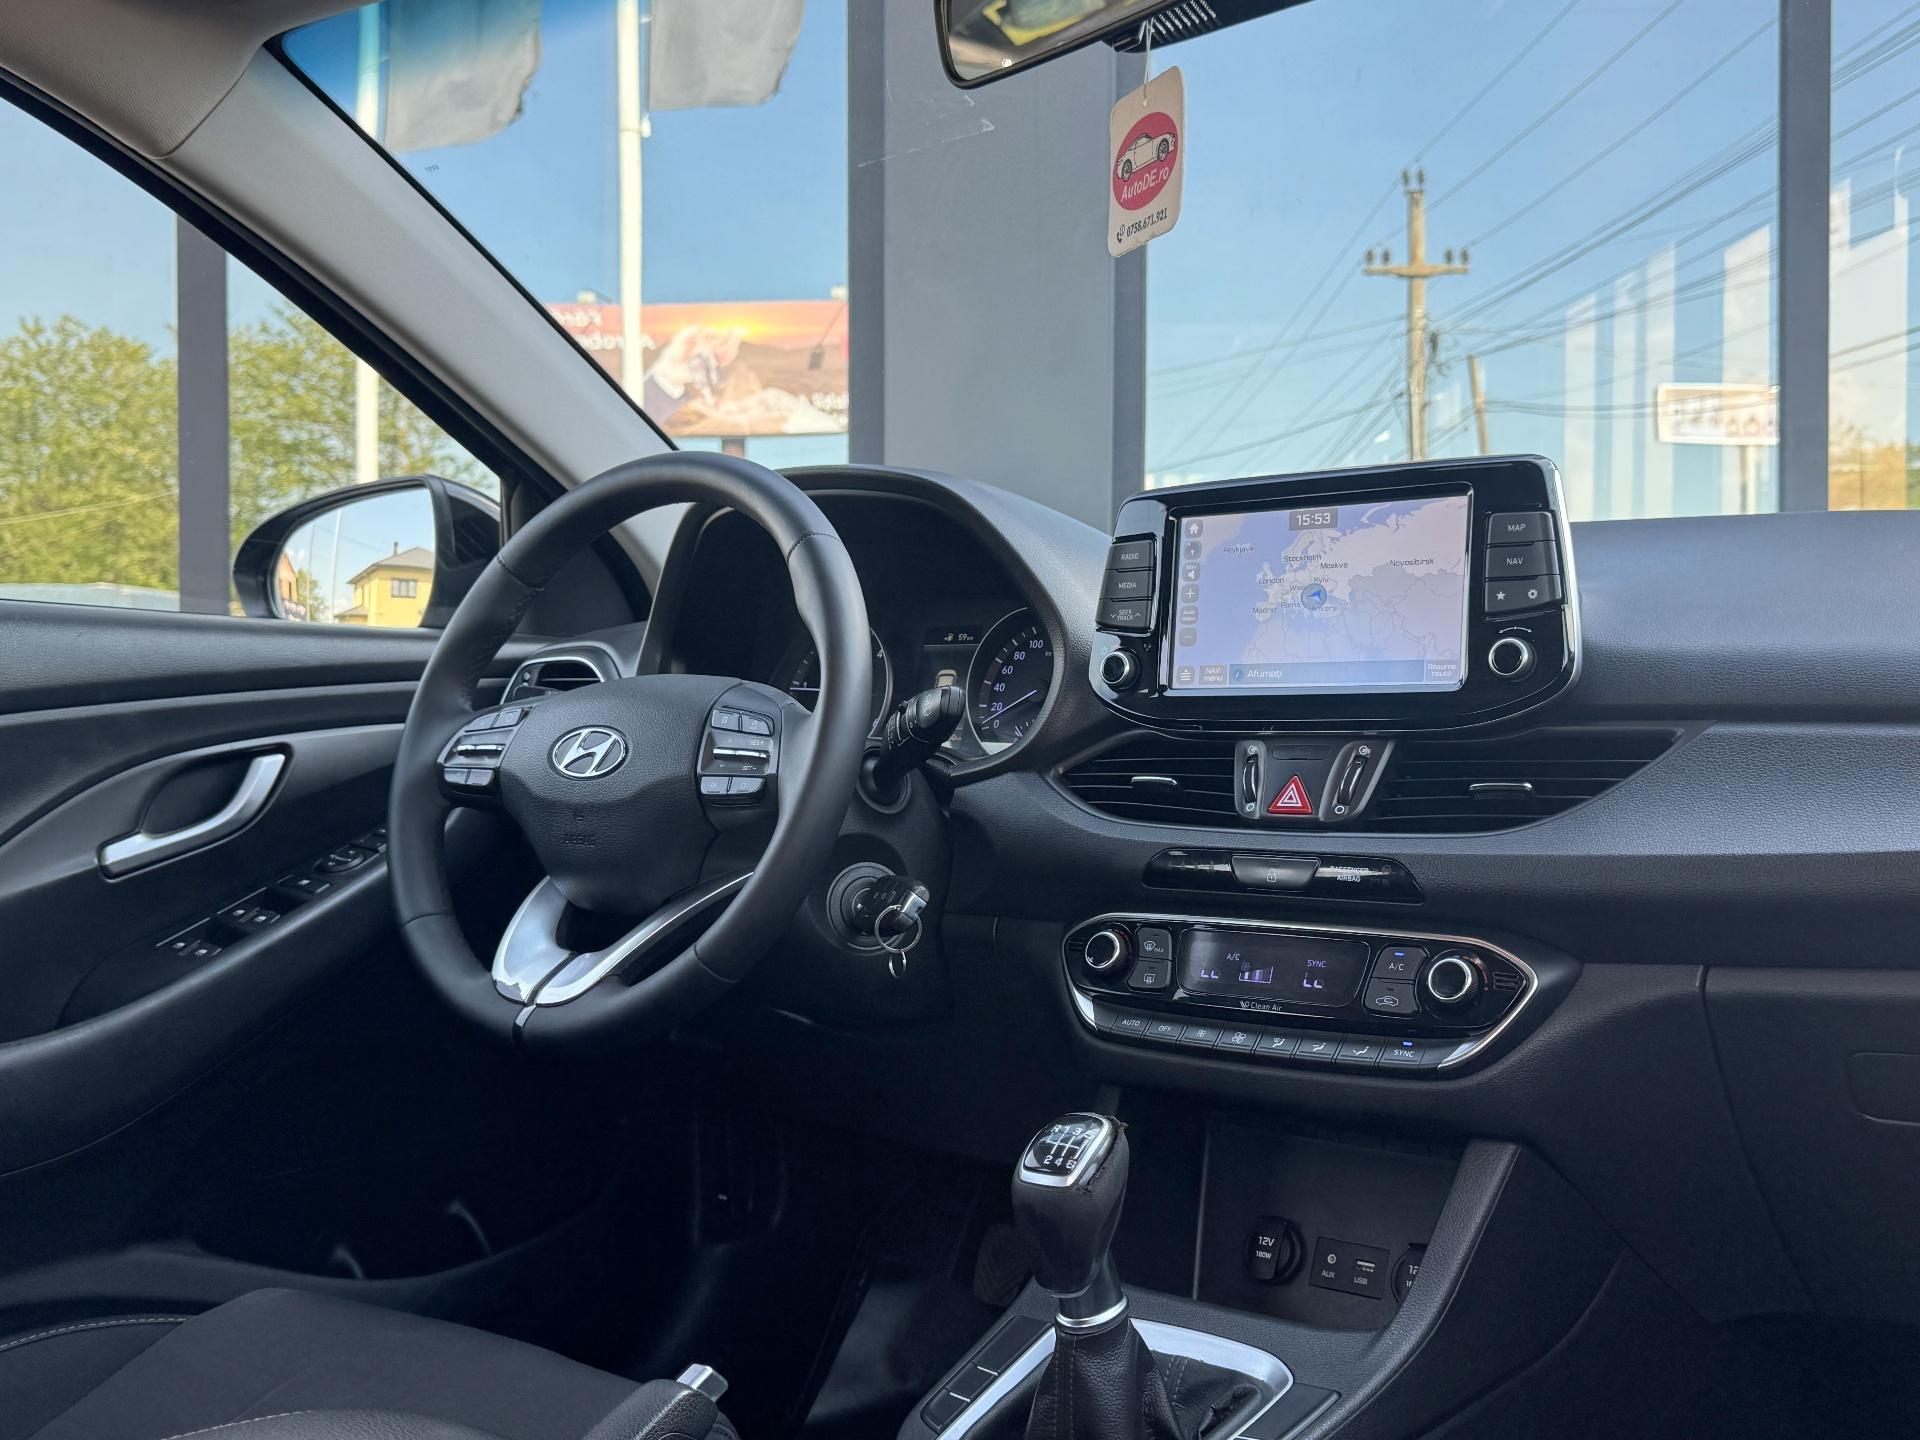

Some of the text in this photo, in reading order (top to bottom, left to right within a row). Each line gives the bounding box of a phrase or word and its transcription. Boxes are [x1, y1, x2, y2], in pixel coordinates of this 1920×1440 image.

[1120, 167, 1169, 203] AutoDE.ro
[1126, 207, 1168, 238] 0758.671.921
[1296, 512, 1331, 526] 15:53
[1507, 523, 1526, 532] MAP
[1121, 553, 1139, 561] RADIO
[1283, 554, 1322, 563] Stockholm
[1506, 557, 1524, 565] NAV
[1320, 562, 1348, 570] Moskva
[1389, 558, 1435, 567] Novosibirsk
[1258, 577, 1285, 585] London
[1313, 576, 1329, 584] Kyiv
[1118, 581, 1137, 589] MEDIA
[1028, 640, 1044, 649] 100
[1013, 651, 1026, 660] 80
[1001, 666, 1013, 675] 60
[1427, 663, 1457, 671] Resume
[993, 682, 1005, 692] 40
[991, 702, 1003, 711] 20
[993, 719, 999, 728] 0
[1226, 953, 1240, 961] A/C
[1306, 959, 1327, 968] SYNC
[1388, 962, 1405, 971] A/C
[1250, 1001, 1282, 1012] Clean Air
[1121, 1019, 1141, 1027] AUTO
[1394, 1049, 1415, 1058] SYNC
[1043, 1155, 1053, 1165] 2
[1054, 1157, 1064, 1167] 4
[1258, 1236, 1275, 1247] 12V
[1255, 1250, 1272, 1260] 180W
[1321, 1269, 1335, 1279] AUX
[1409, 1265, 1419, 1275] 12
[1353, 1277, 1368, 1285] USB
